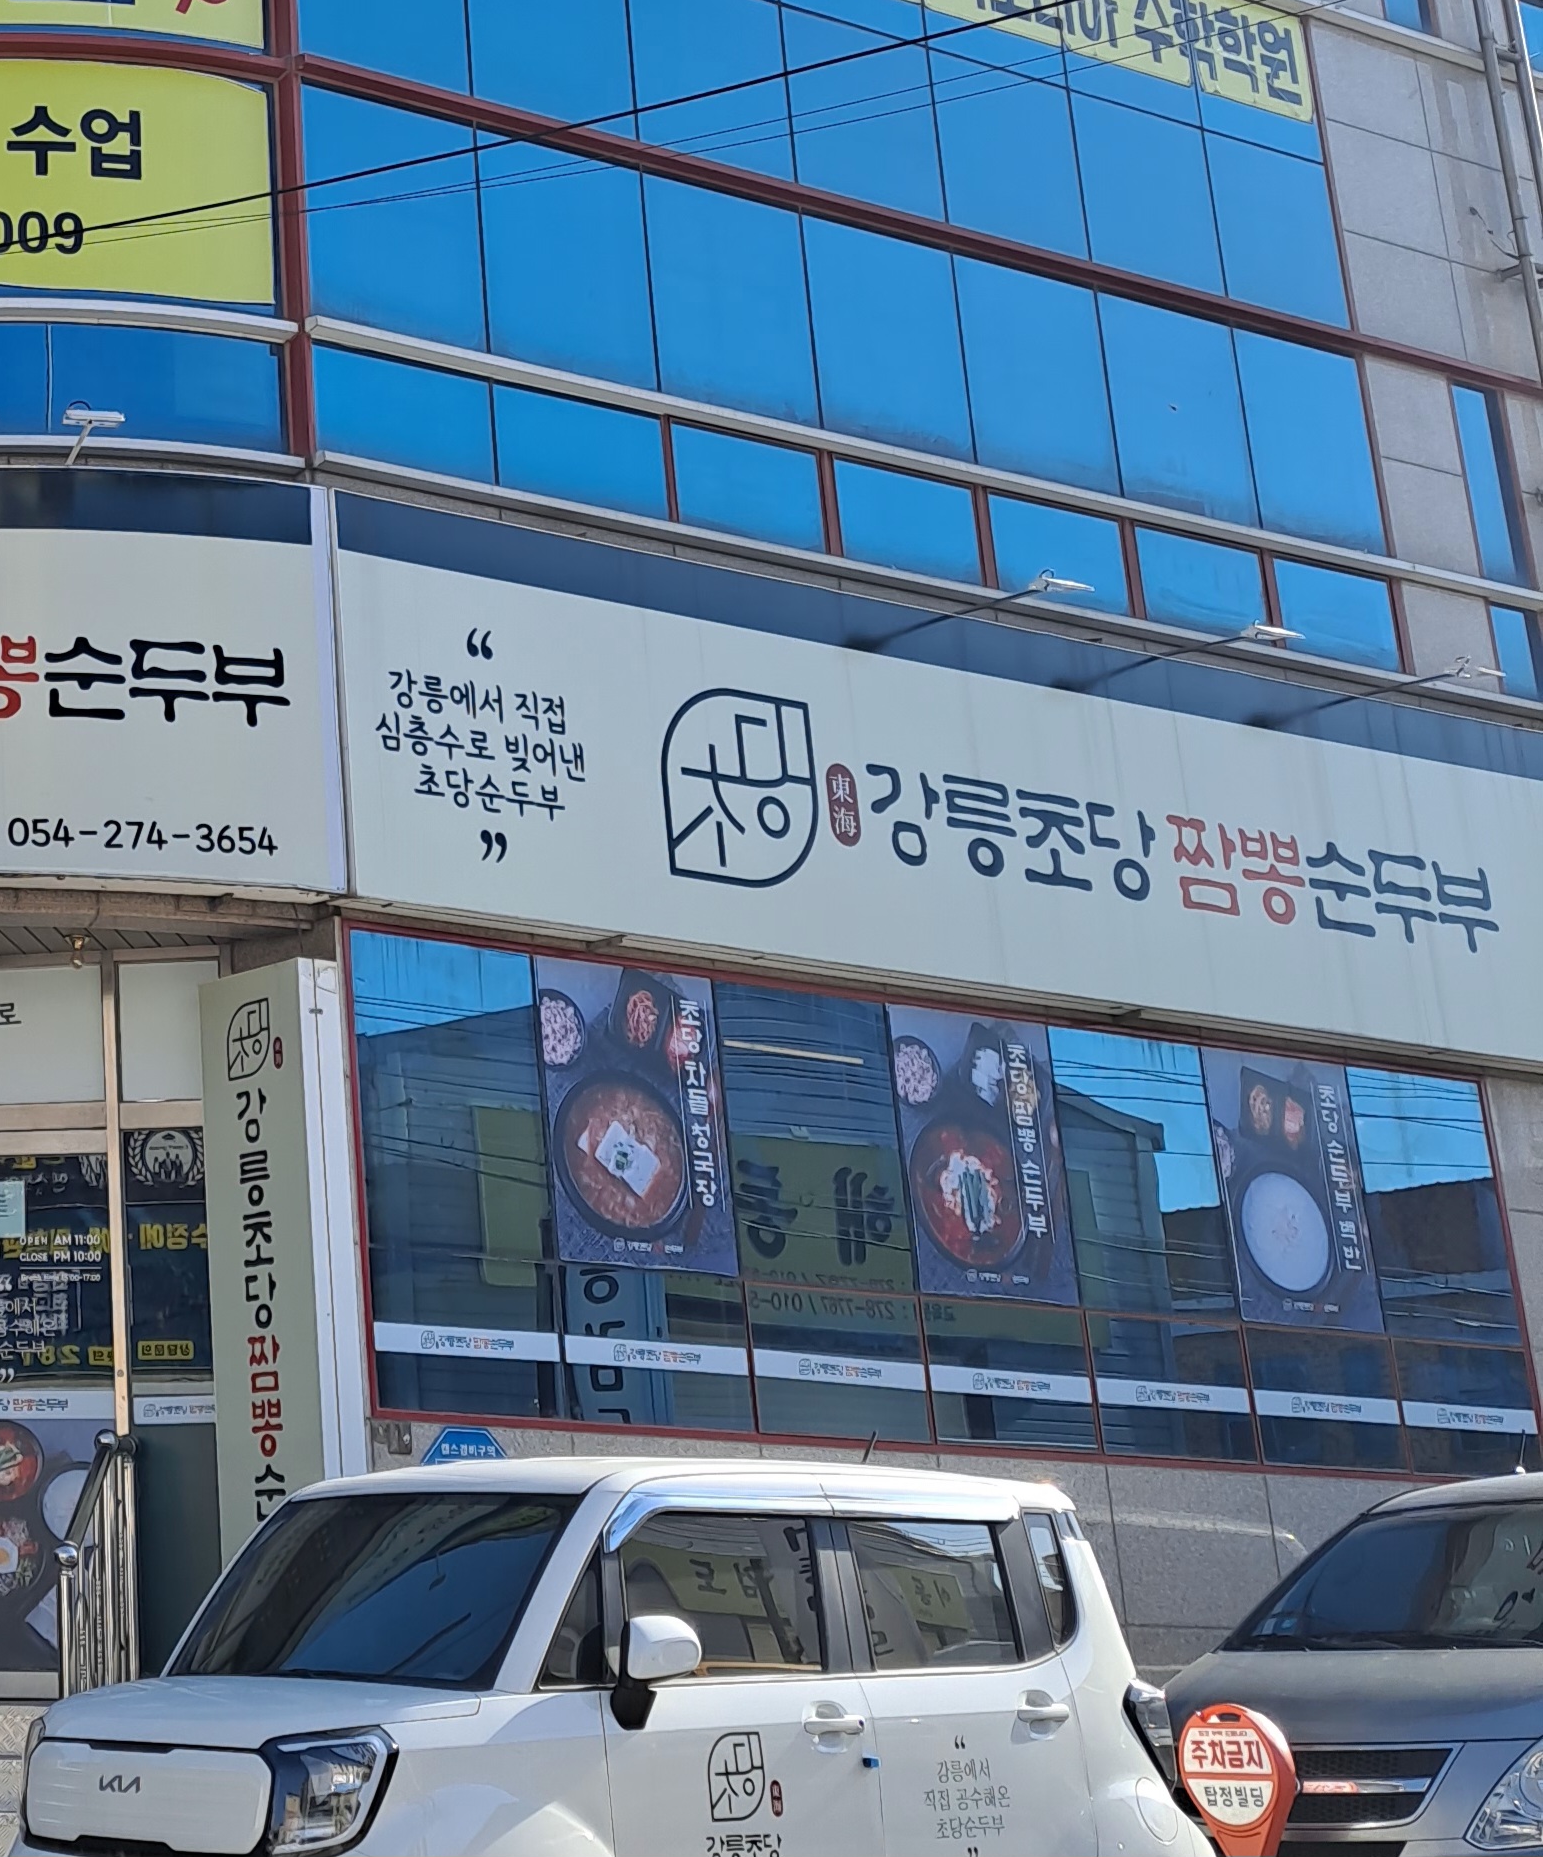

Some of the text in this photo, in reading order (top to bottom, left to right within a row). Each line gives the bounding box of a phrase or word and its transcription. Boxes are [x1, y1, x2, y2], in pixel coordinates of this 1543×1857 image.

[6, 104, 143, 181] 수업
[387, 668, 567, 736] 강릉에서 직접
[375, 710, 587, 783] 심층수로 빚어낸
[414, 763, 566, 822] 초당순두부
[7, 816, 279, 856] 054-274-3654
[19, 1235, 48, 1247] OPEN
[53, 1234, 72, 1246] AM
[19, 1251, 102, 1263] CLOSE PM 10:00
[1191, 1738, 1264, 1770] 주차금지
[936, 1759, 992, 1784] 강릉에서
[924, 1789, 951, 1811] 직접
[936, 1816, 1007, 1840] 초당순두부
